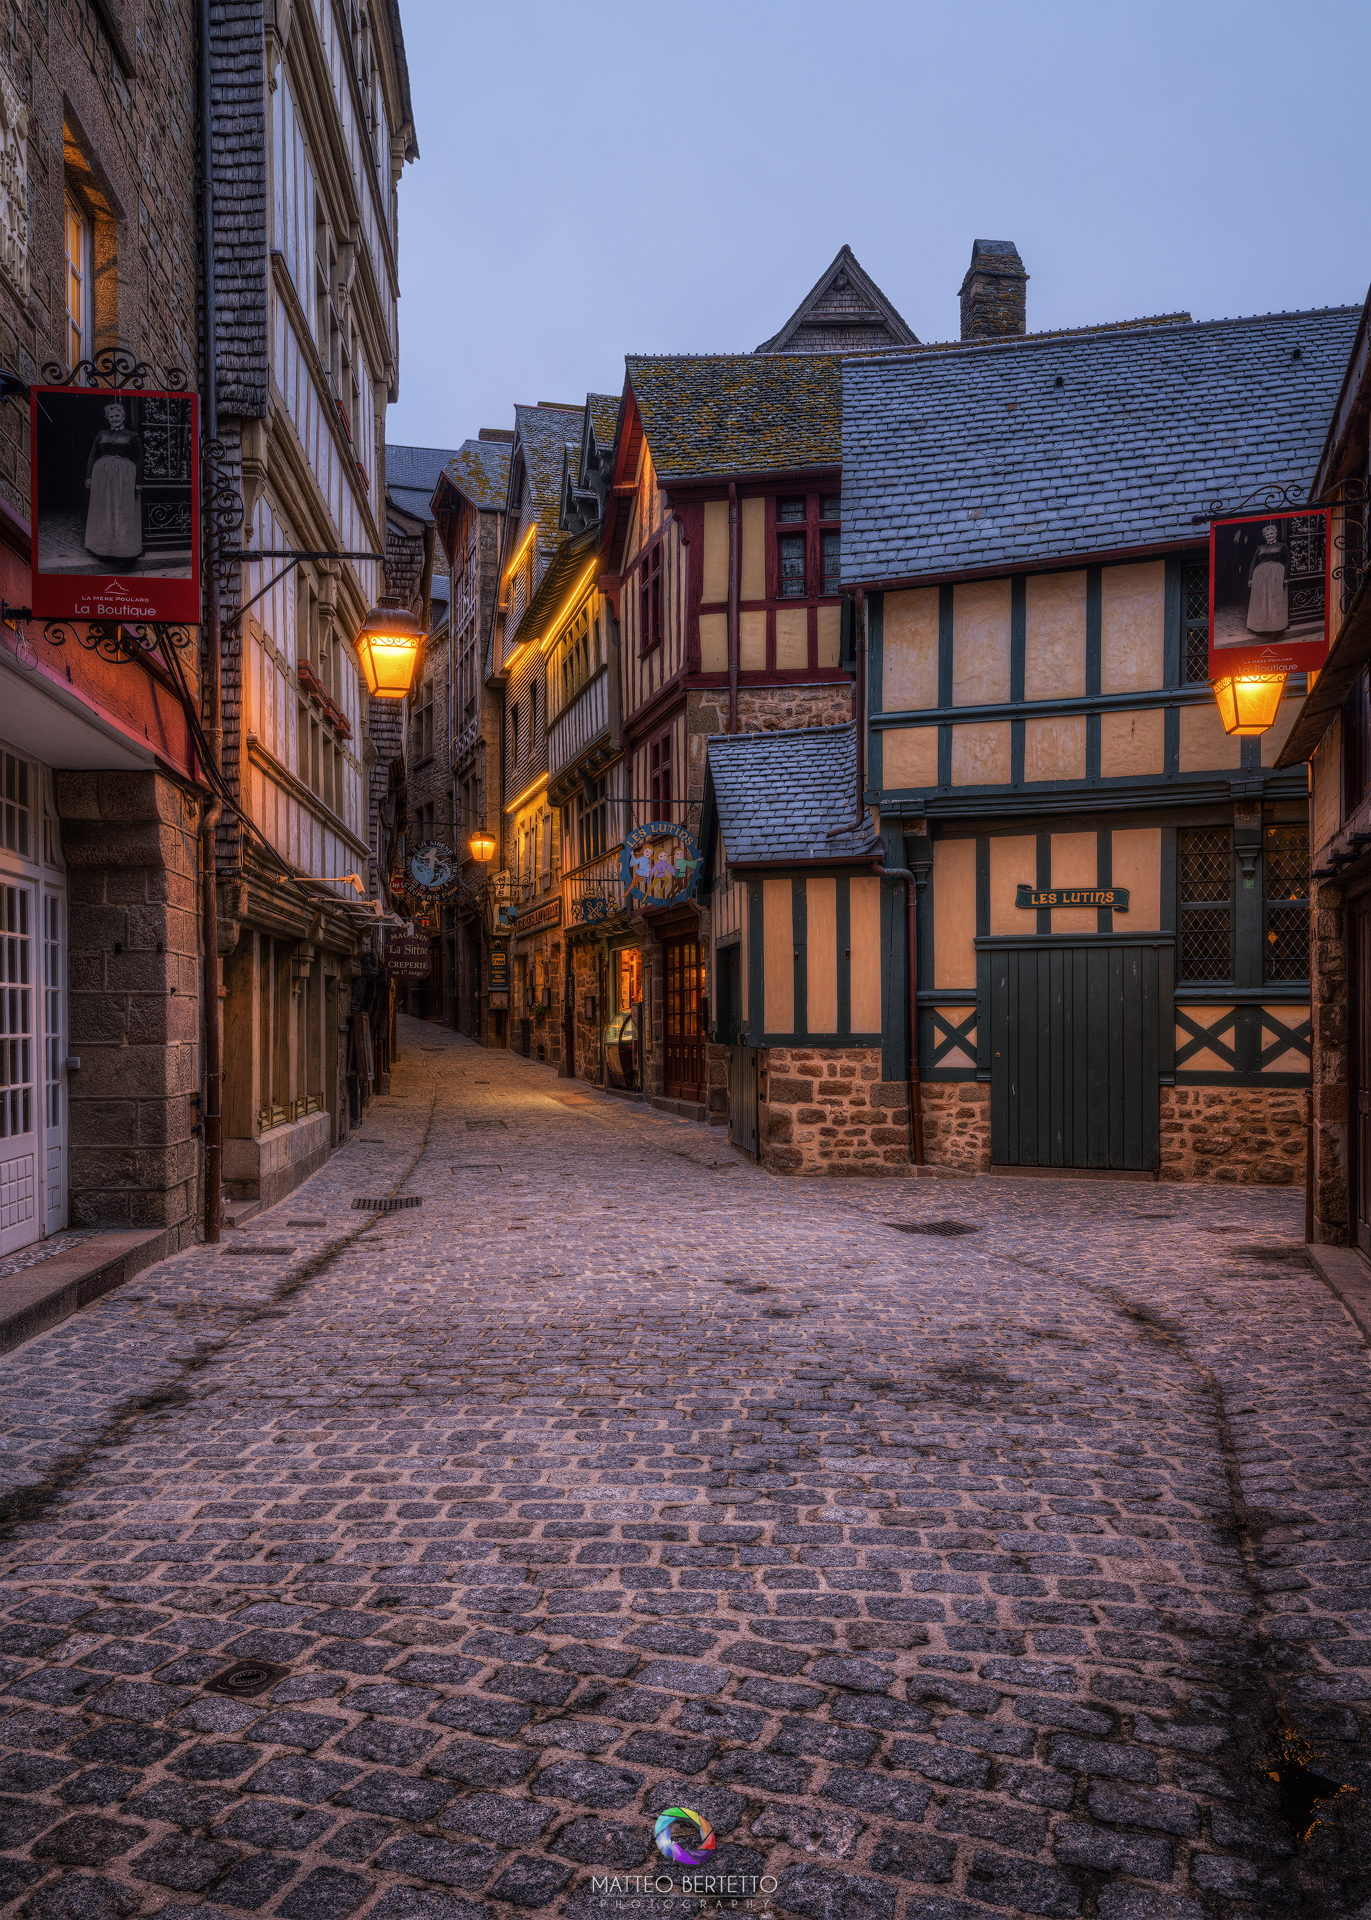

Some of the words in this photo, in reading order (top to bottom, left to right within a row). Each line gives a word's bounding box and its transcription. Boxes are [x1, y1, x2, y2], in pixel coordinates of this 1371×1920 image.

[74, 603, 90, 614] La
[97, 604, 157, 618] Boutique
[1238, 666, 1250, 674] La
[1254, 663, 1298, 672] Boutique
[626, 828, 647, 848] LES
[650, 823, 694, 846] LUTINS
[1031, 893, 1057, 905] LES
[1062, 891, 1115, 905] LUTINS
[390, 932, 429, 942] MAGSIN
[387, 960, 428, 970] CREPERIE
